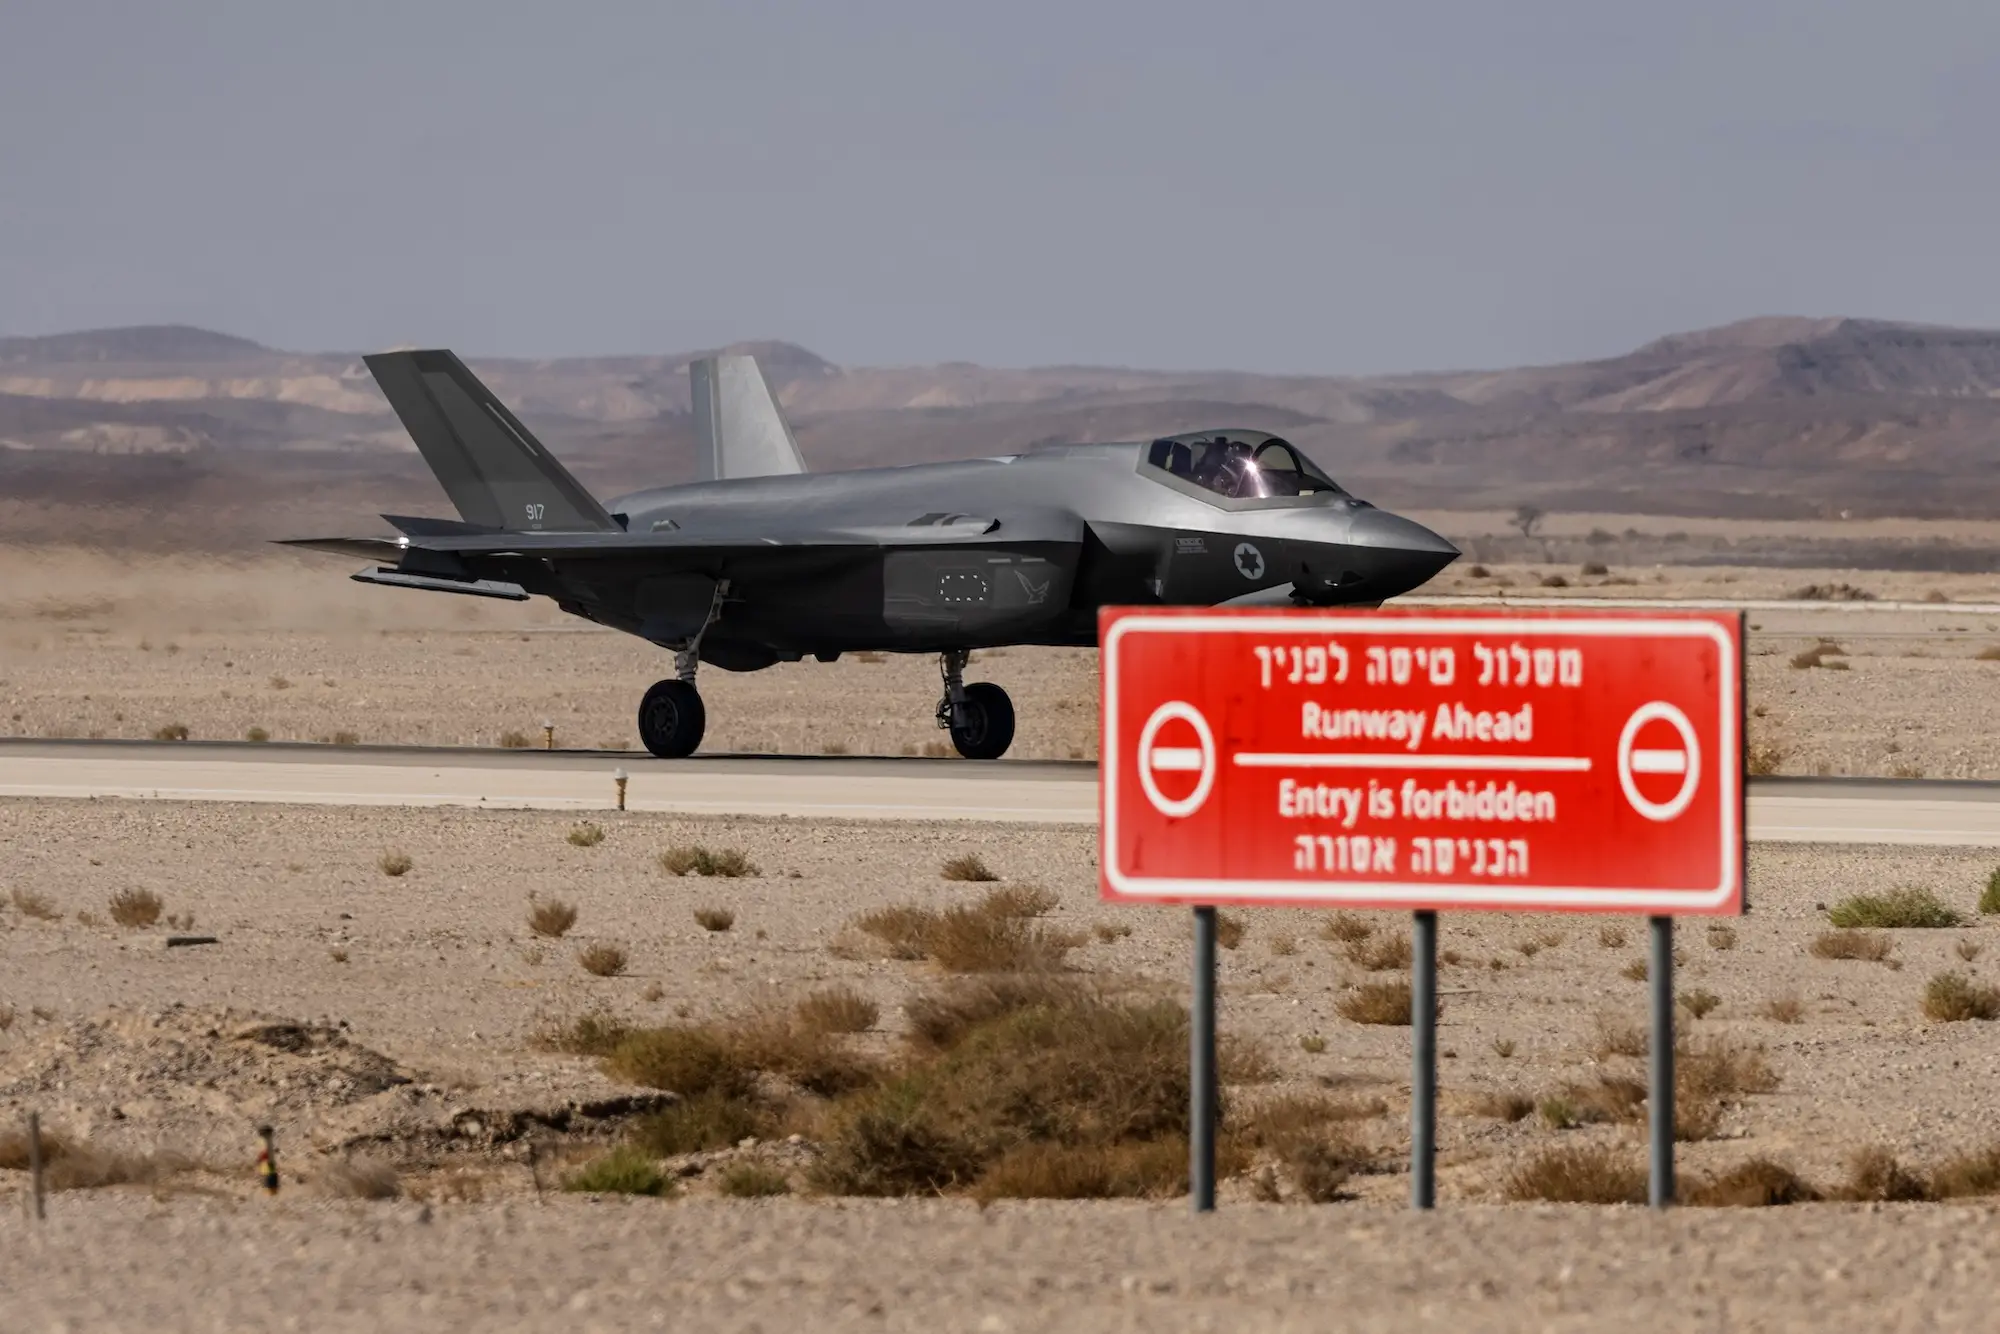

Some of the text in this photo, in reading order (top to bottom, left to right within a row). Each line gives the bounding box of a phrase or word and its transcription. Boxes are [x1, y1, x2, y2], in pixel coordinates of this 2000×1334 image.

[525, 503, 545, 520] 917
[1254, 641, 1582, 688] מסלול טיסה לפניך
[1302, 701, 1533, 750] Runway Ahead
[1278, 778, 1556, 829] Entry is forbidden
[1294, 834, 1529, 877] הכניסה אסורה
